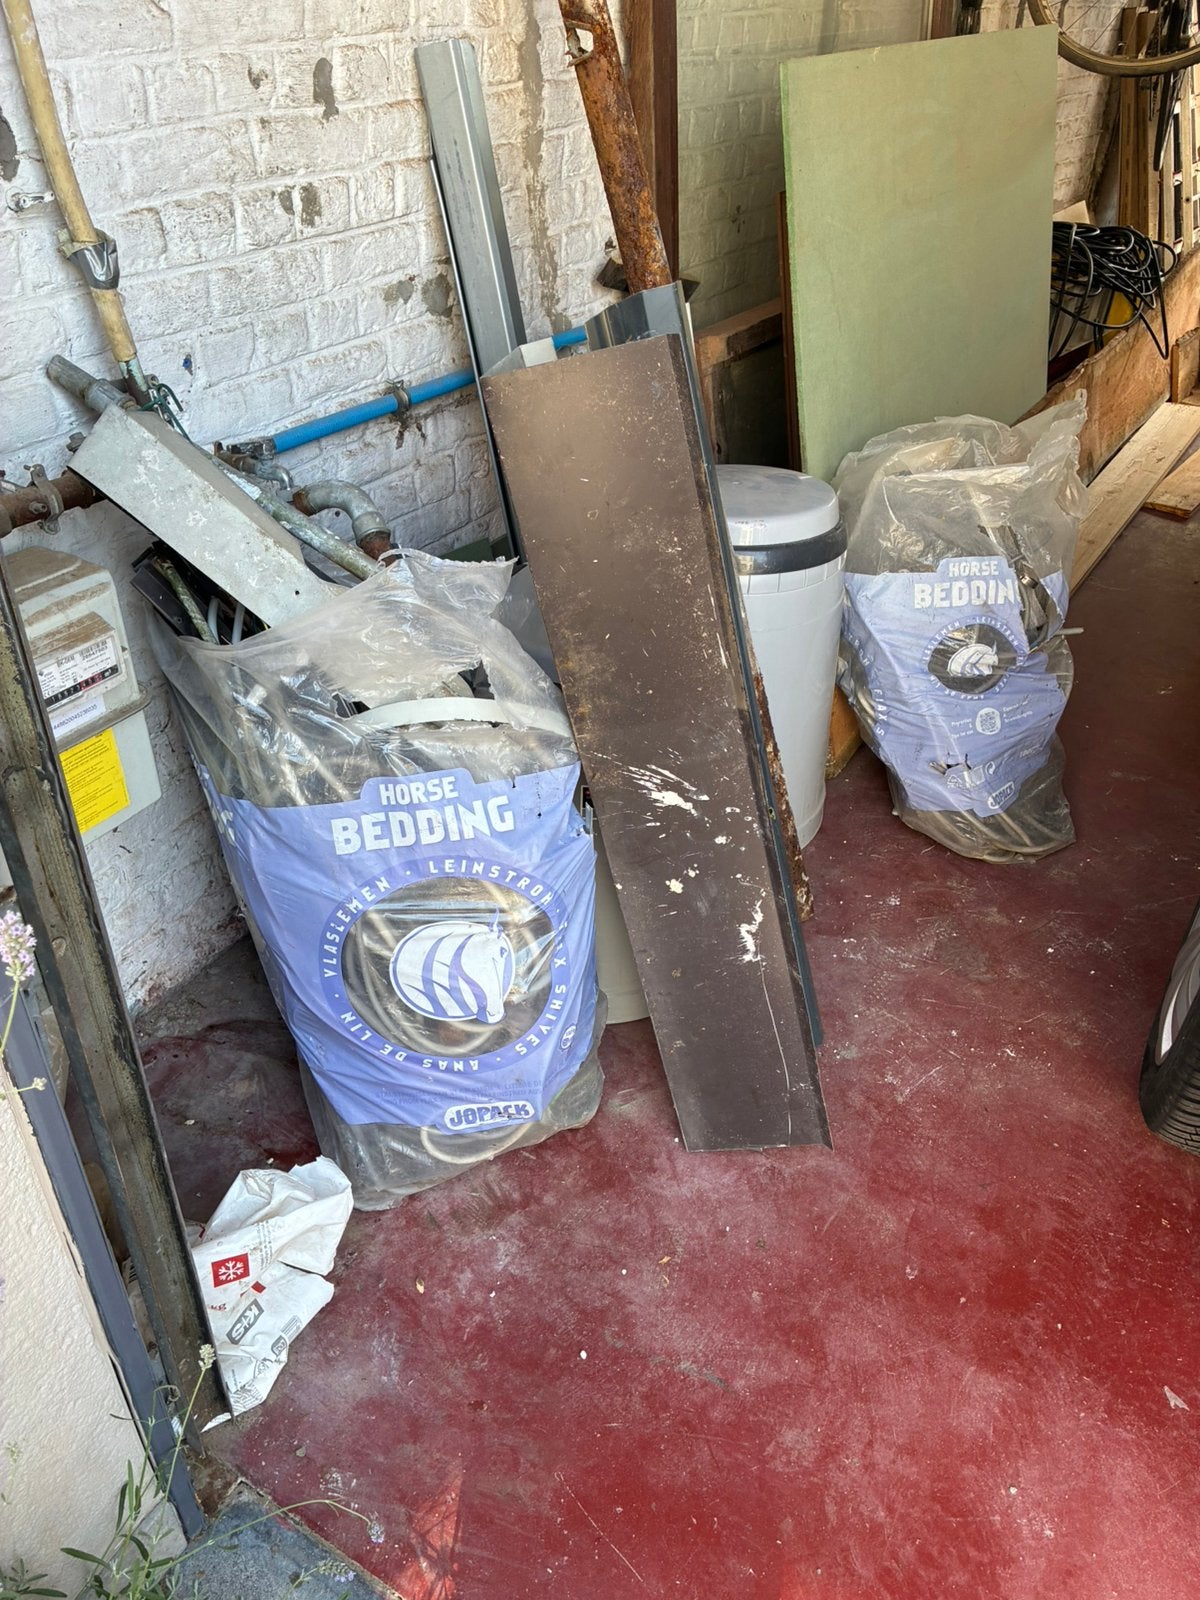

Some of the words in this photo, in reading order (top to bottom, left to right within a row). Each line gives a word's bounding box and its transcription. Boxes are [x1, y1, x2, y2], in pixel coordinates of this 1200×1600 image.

[949, 560, 999, 577] HORSE
[914, 579, 1021, 608] BEDDIN
[379, 777, 459, 806] HORSE
[331, 795, 515, 856] BEDDING
[428, 859, 554, 906] LEINSTROH
[339, 1010, 376, 1037] LIN
[515, 983, 568, 1056] SHIVES
[380, 1043, 408, 1062] DE
[421, 1057, 480, 1073] ANAS
[449, 1103, 531, 1128] JOPACK
[231, 1303, 260, 1341] K+S
